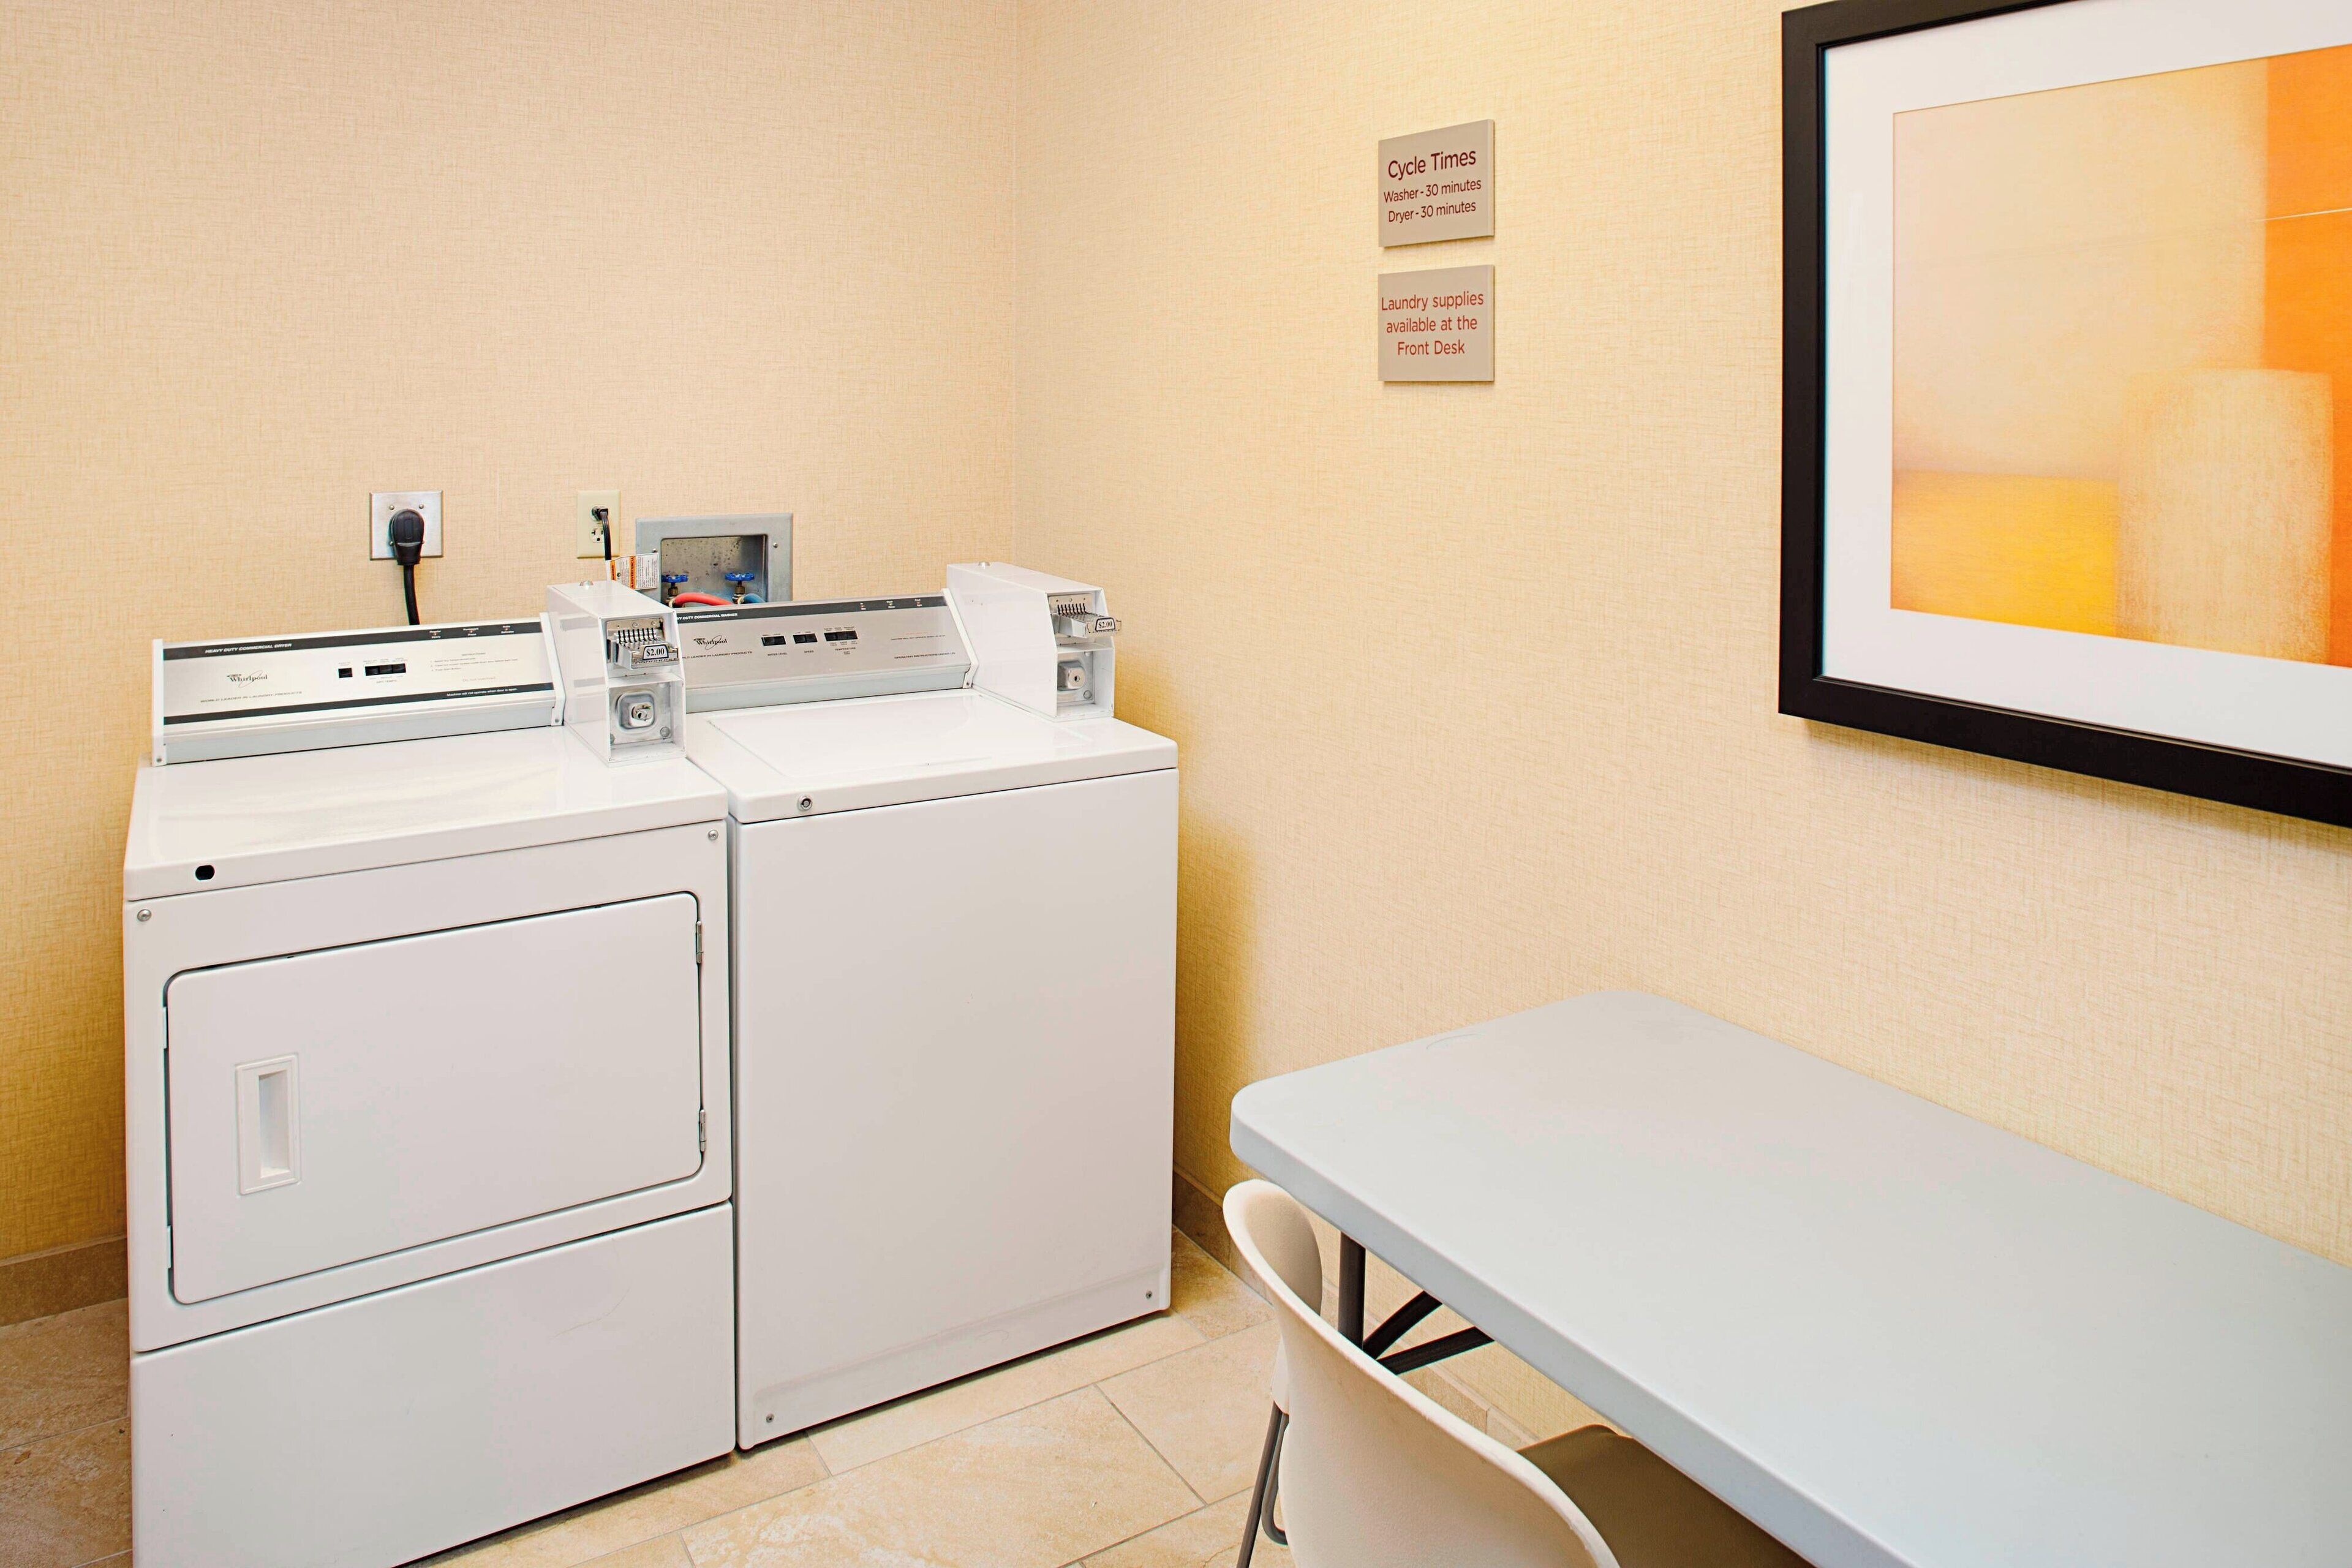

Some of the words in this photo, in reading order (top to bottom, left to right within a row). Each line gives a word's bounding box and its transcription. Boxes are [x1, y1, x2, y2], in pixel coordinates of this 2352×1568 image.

[1388, 156, 1426, 181] Cycle
[1430, 150, 1477, 171] Times
[1441, 179, 1482, 195] minutes
[1436, 202, 1476, 216] minutes
[1381, 294, 1428, 311] Laundry
[1432, 291, 1484, 309] supplies
[1386, 317, 1436, 333] available
[1441, 317, 1453, 331] at
[1457, 315, 1477, 330] the
[1397, 341, 1430, 355] Front
[1434, 339, 1466, 355] Desk
[646, 647, 665, 657] $2.00
